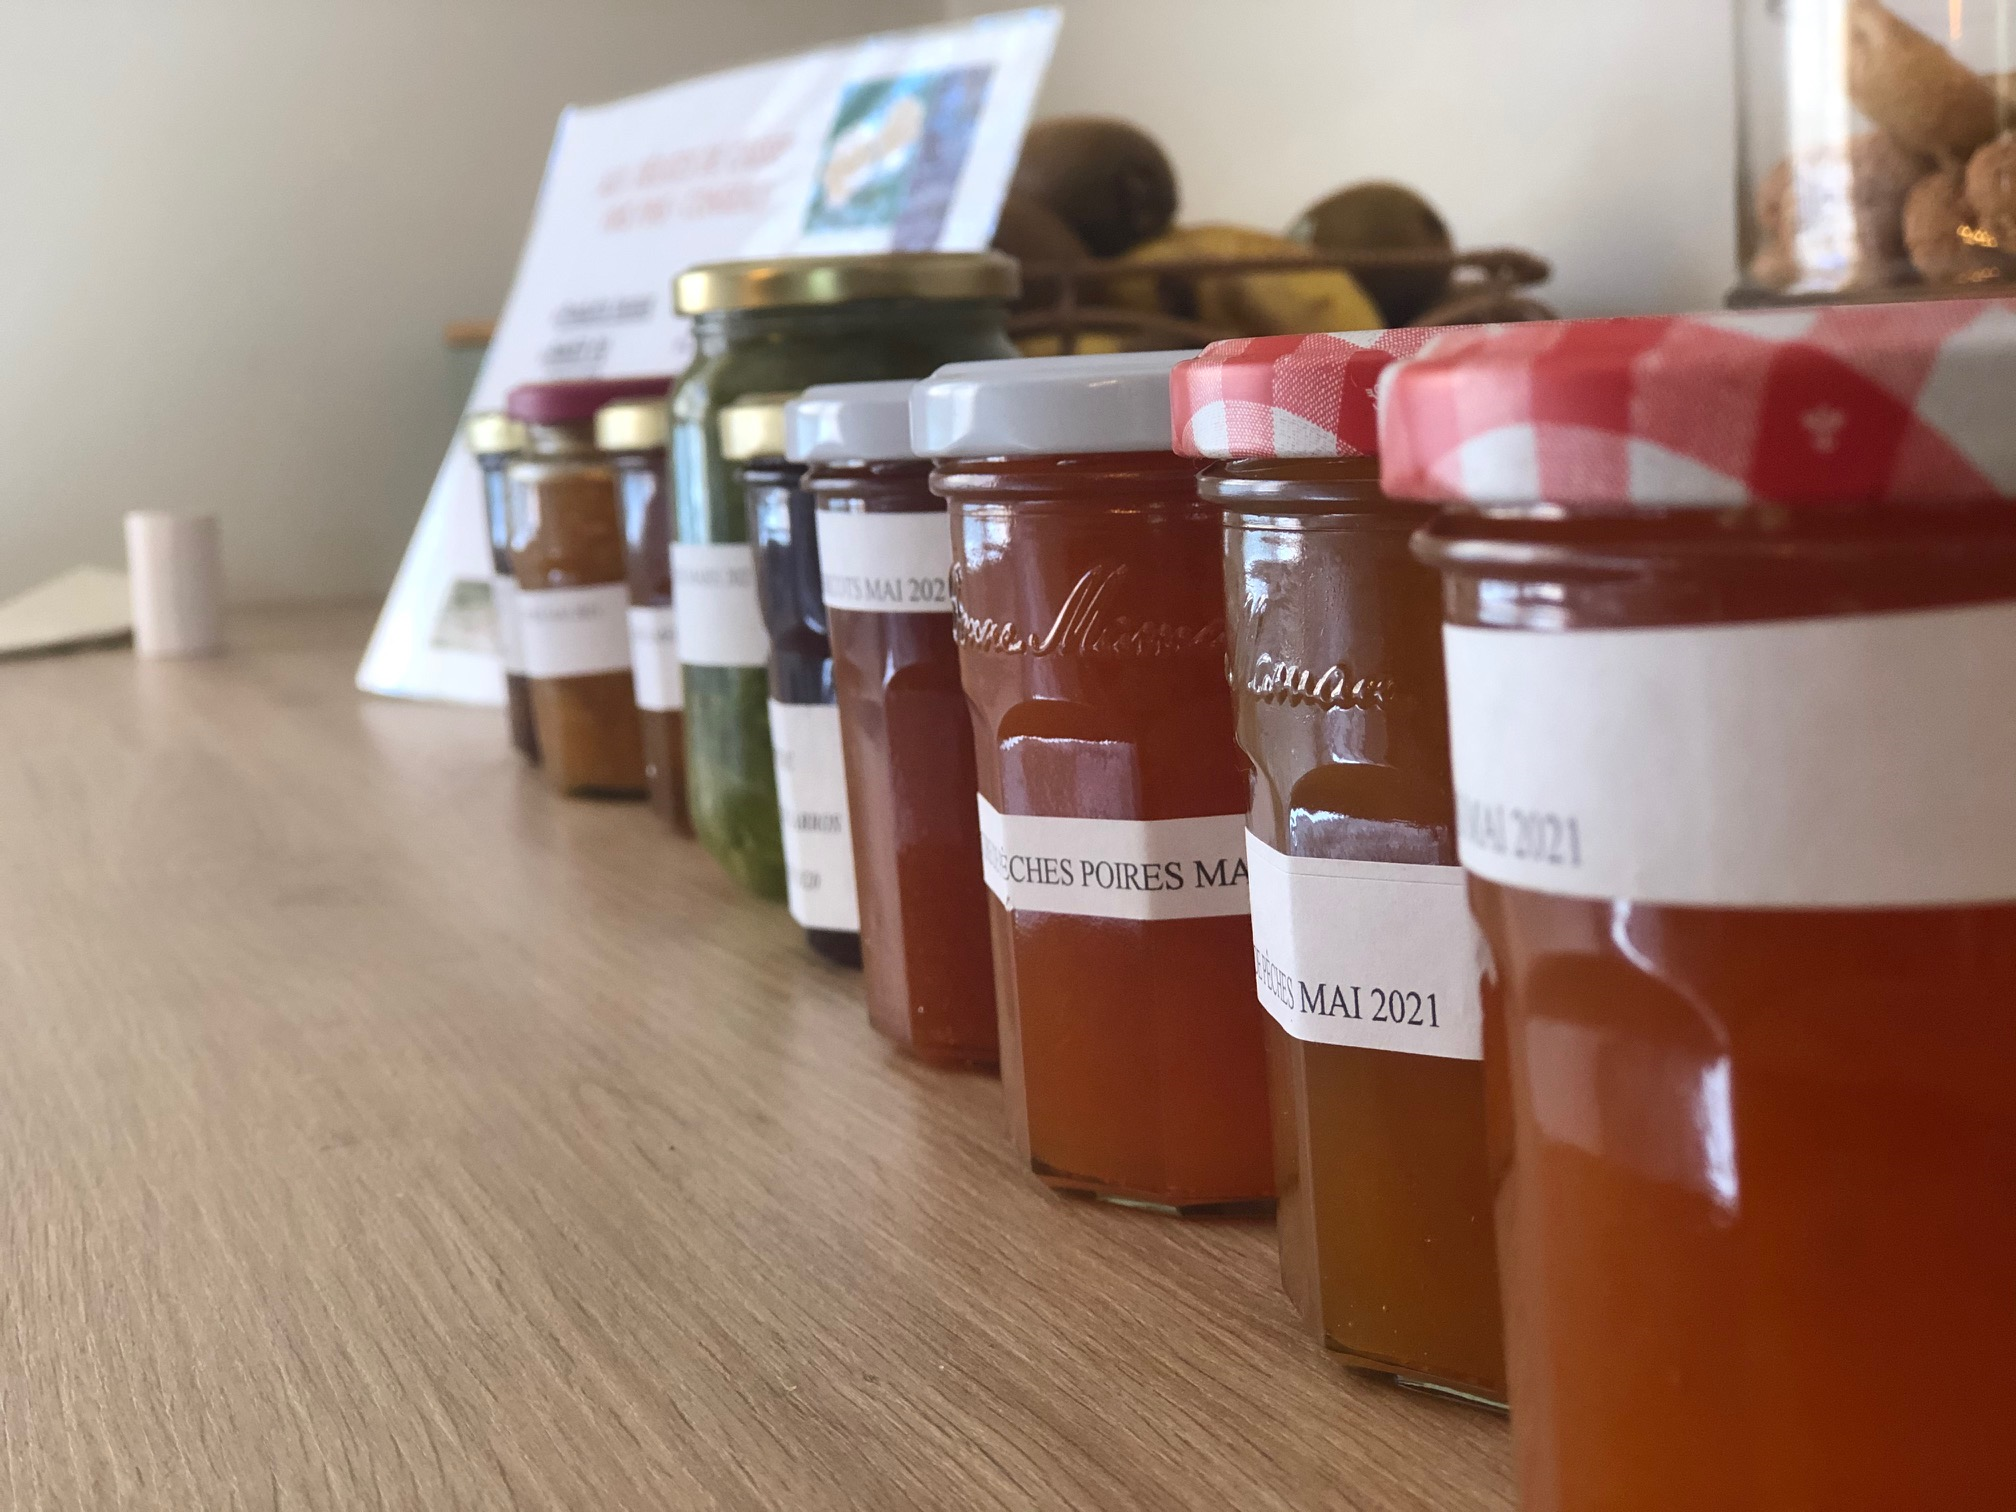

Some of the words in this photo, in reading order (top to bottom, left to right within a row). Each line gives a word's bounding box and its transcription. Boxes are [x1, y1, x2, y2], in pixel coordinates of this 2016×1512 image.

[864, 576, 904, 603] MAI
[906, 576, 947, 603] 202
[1510, 805, 1583, 869] 2021
[1079, 859, 1185, 892] POIRES
[1193, 856, 1249, 889] MA
[1297, 979, 1364, 1020] MAI
[1370, 987, 1441, 1029] 2021
